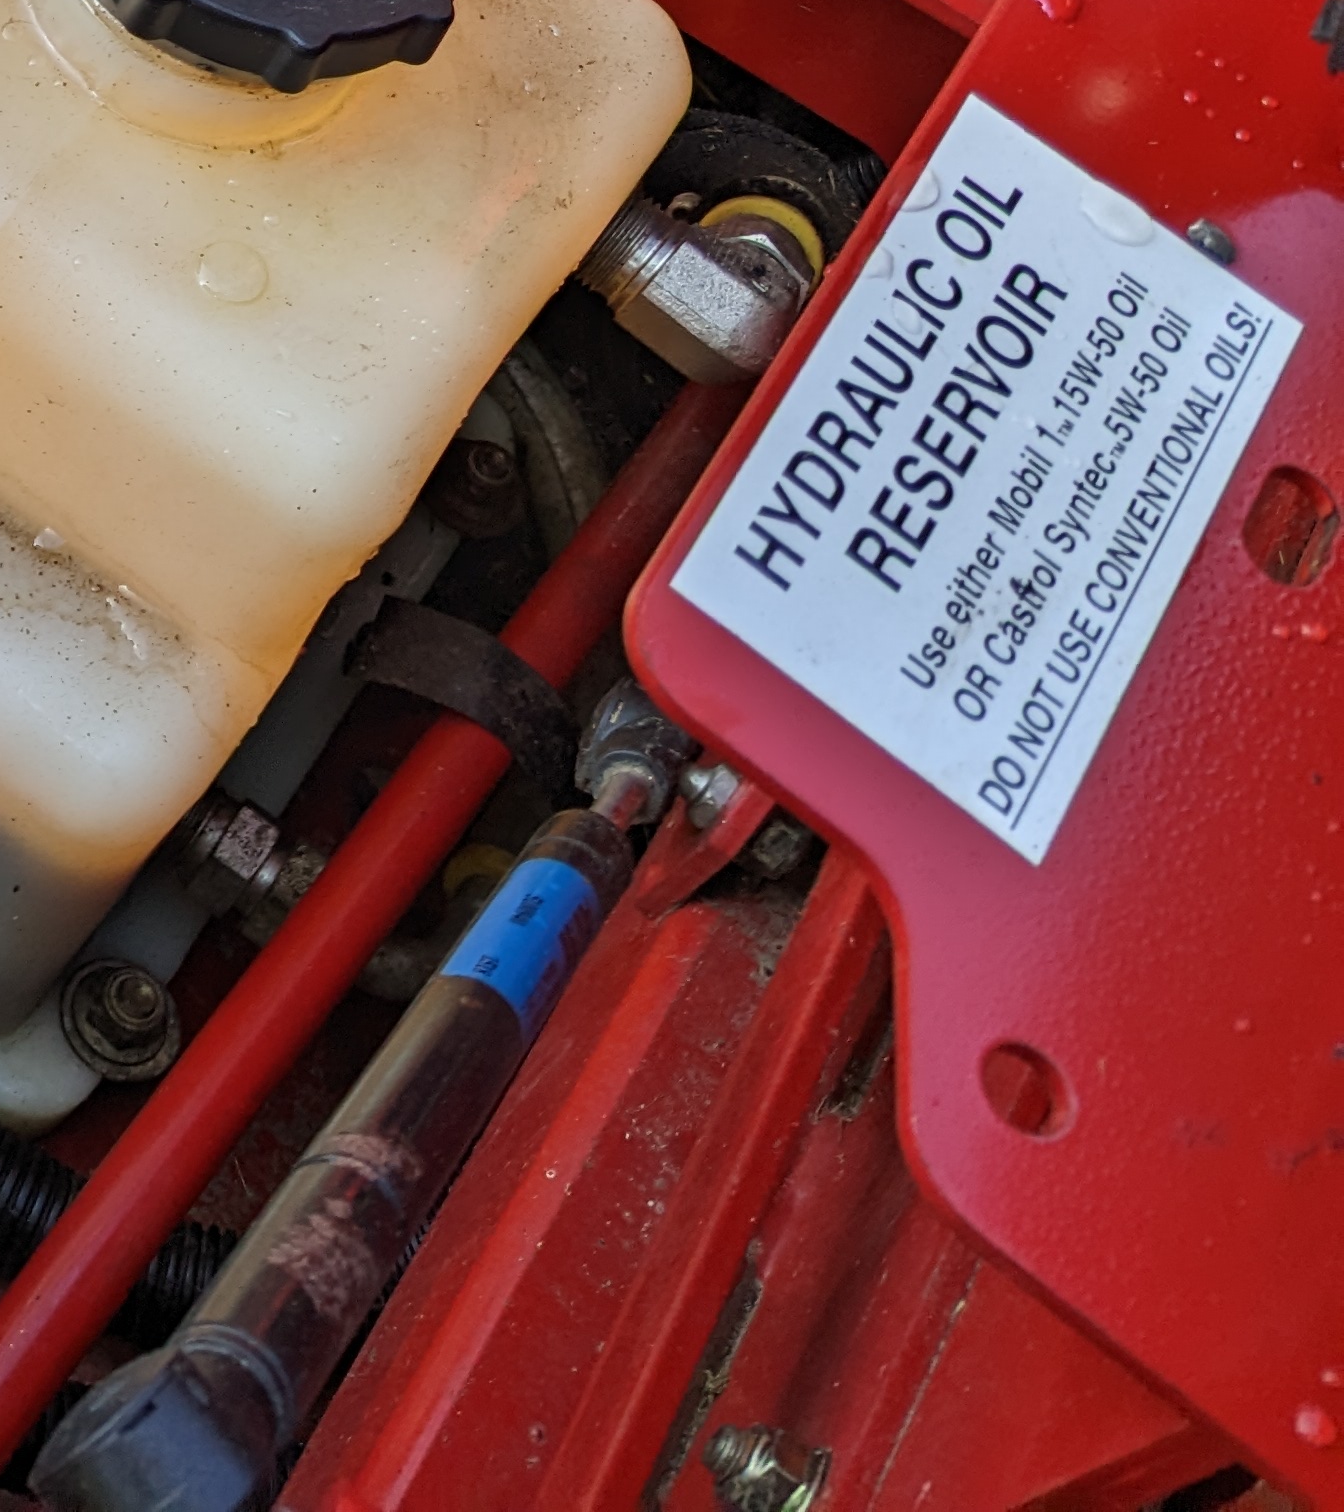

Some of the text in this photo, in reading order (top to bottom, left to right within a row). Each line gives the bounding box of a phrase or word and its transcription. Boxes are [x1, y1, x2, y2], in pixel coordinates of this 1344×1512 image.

[734, 174, 1024, 591] HYDRAULIC OIL
[844, 262, 1068, 593] RESERVOIR
[899, 624, 956, 689] Use
[944, 531, 1005, 625] either
[986, 444, 1053, 536] Mobil
[1106, 271, 1149, 318] Oil
[952, 663, 1002, 722] OR
[982, 548, 1062, 665] Castrol
[1149, 305, 1191, 353] Oil
[977, 300, 1262, 816] DO NOT USE CONVENTIONAL OILS!
